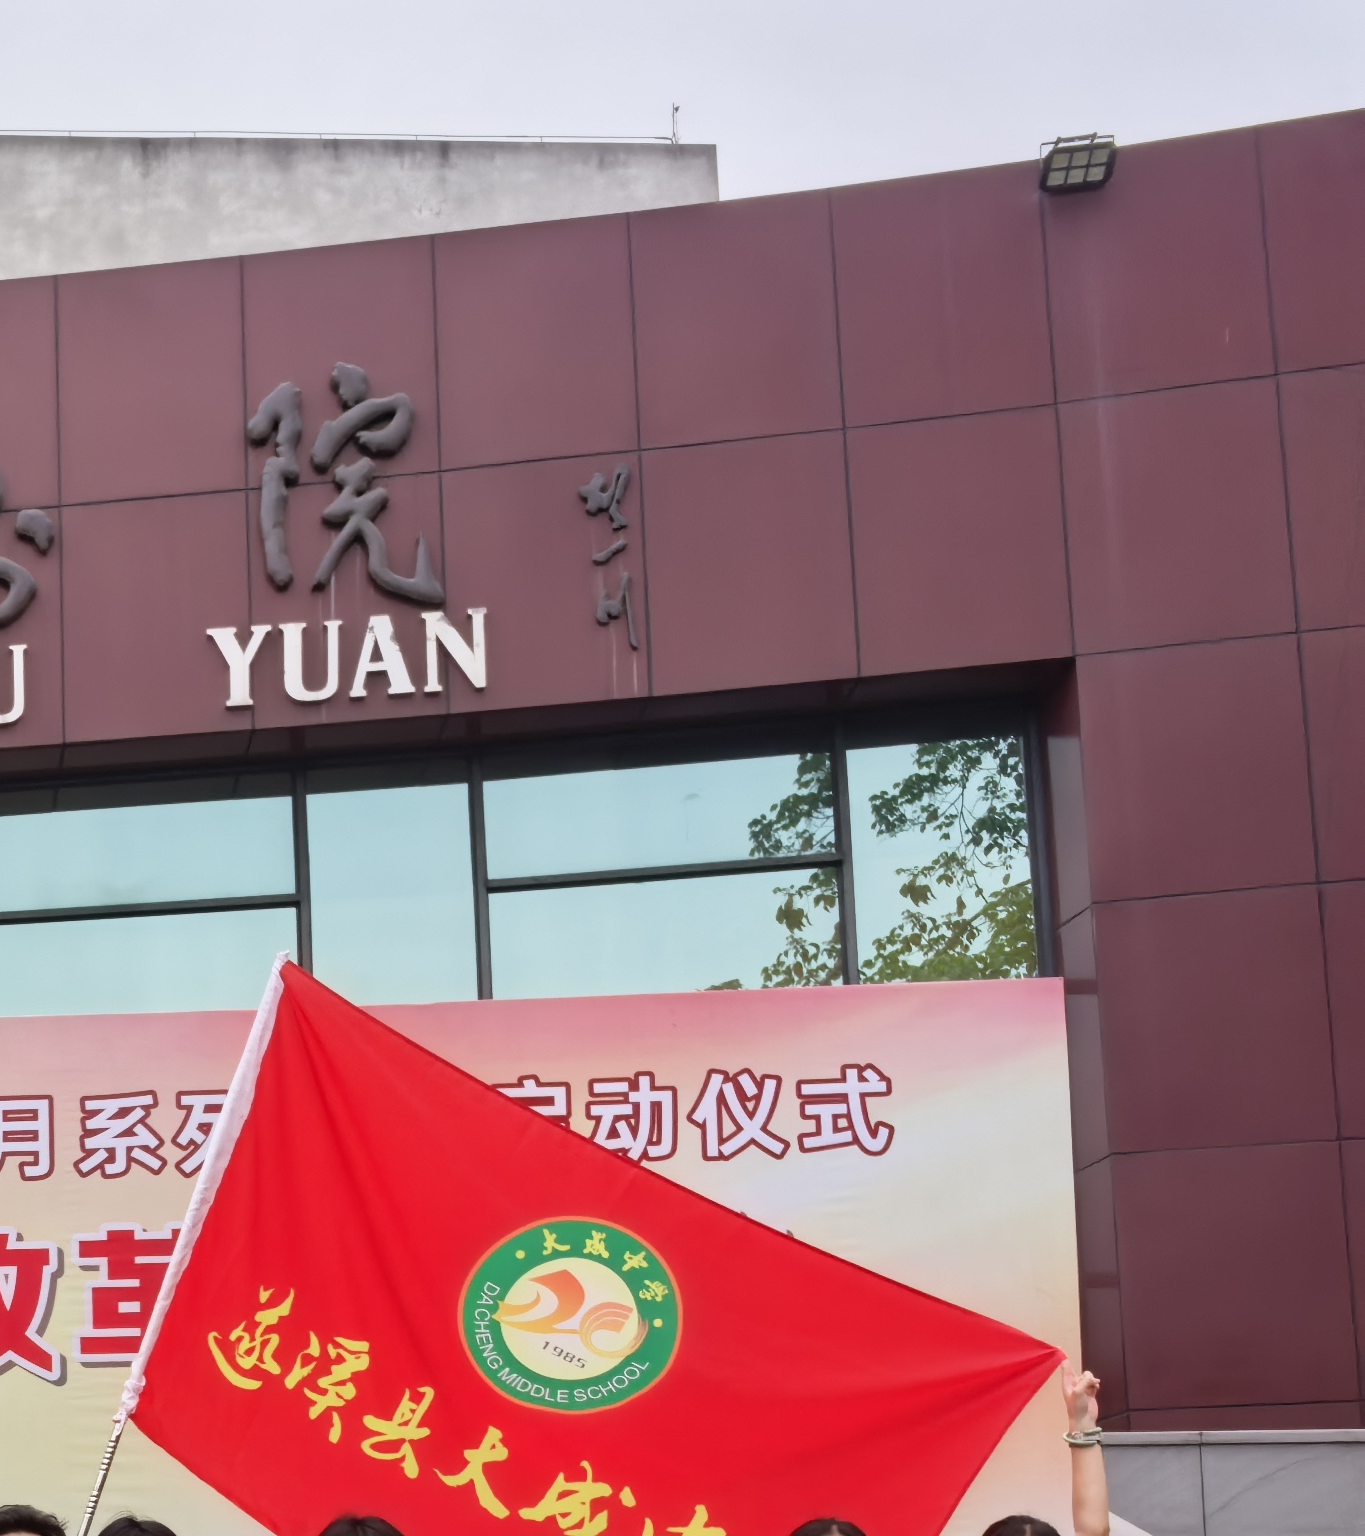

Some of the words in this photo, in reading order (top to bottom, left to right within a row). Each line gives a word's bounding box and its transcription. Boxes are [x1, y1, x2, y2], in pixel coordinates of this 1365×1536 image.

[206, 607, 487, 709] YUAN
[477, 1281, 501, 1306] DA
[474, 1308, 503, 1370] CHENG
[541, 1340, 589, 1370] 1985
[497, 1367, 569, 1403] MIDDLE
[573, 1360, 650, 1402] SCHOOL
